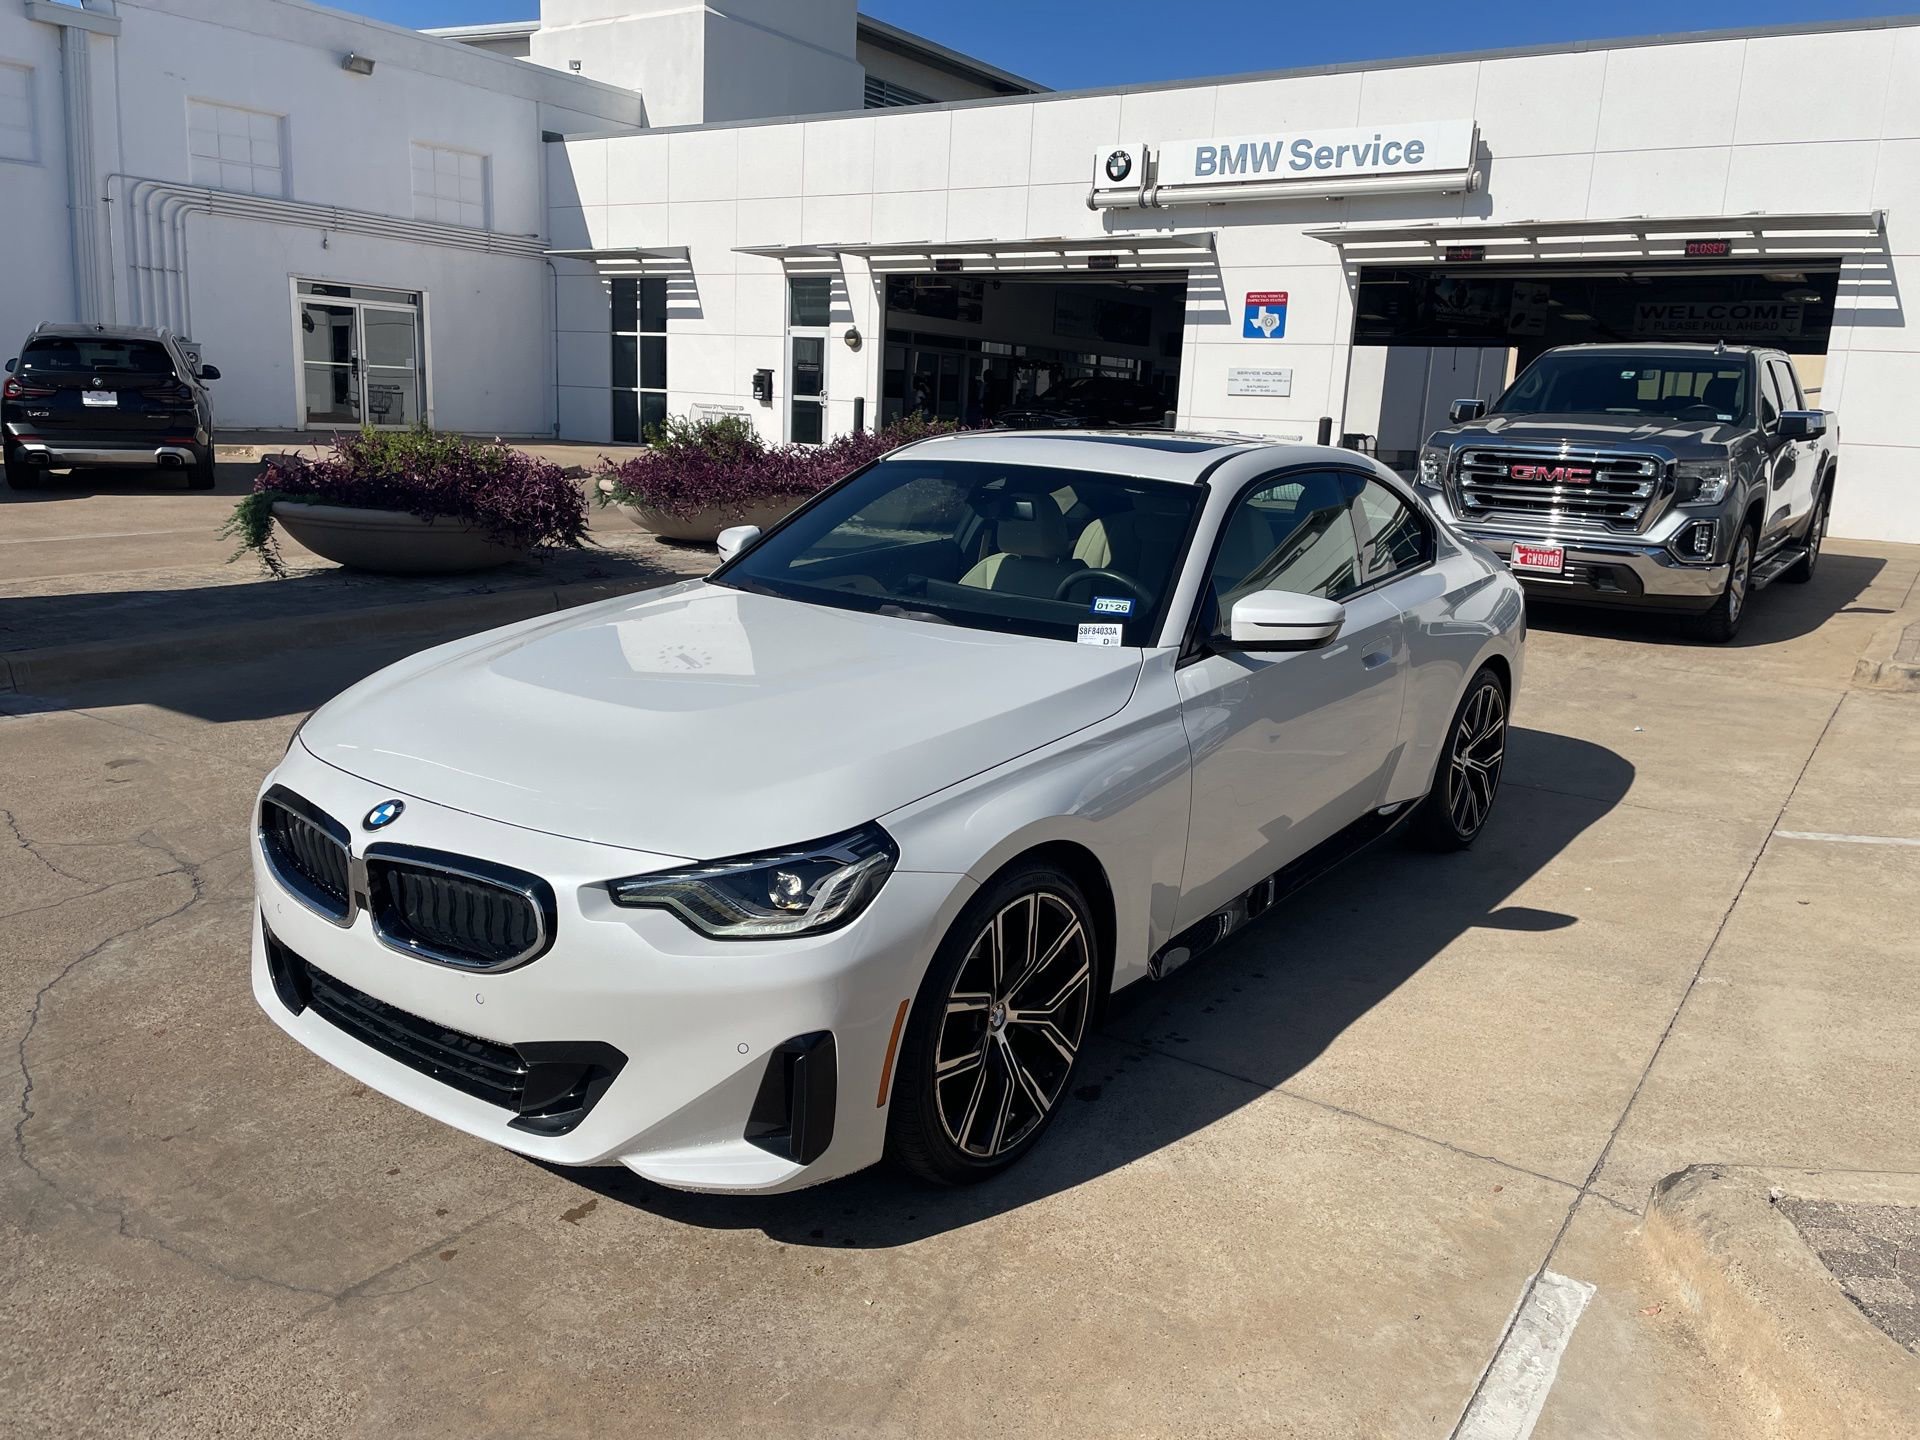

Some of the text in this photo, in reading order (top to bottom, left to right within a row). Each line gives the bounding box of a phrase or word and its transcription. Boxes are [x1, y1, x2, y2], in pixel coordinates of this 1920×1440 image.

[1194, 133, 1426, 177] BMW Service
[1688, 242, 1726, 254] CLOSED
[1639, 305, 1800, 320] WELCOME
[1654, 320, 1778, 331] PLEASE PULL AHEAD
[1511, 465, 1592, 484] GMC
